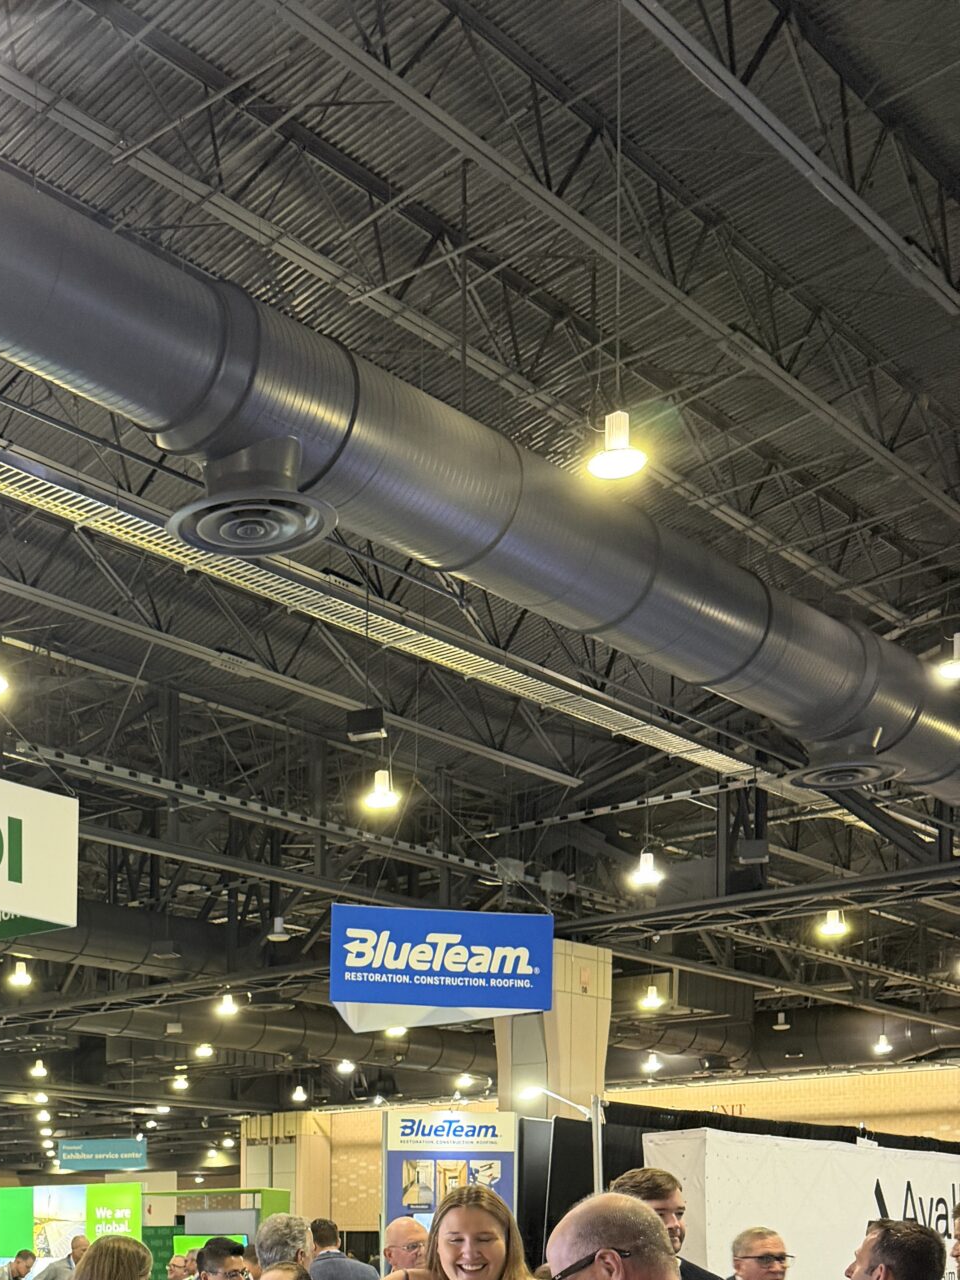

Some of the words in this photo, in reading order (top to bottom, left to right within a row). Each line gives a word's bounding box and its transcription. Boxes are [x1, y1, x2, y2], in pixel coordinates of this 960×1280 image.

[345, 971, 412, 984] RESTORATION.
[414, 976, 489, 987] CONSTRUCTION.
[490, 978, 533, 988] ROOFING.
[62, 1152, 94, 1160] Exhibitor
[95, 1151, 119, 1159] service
[95, 1206, 113, 1219] We
[114, 1208, 131, 1219] are
